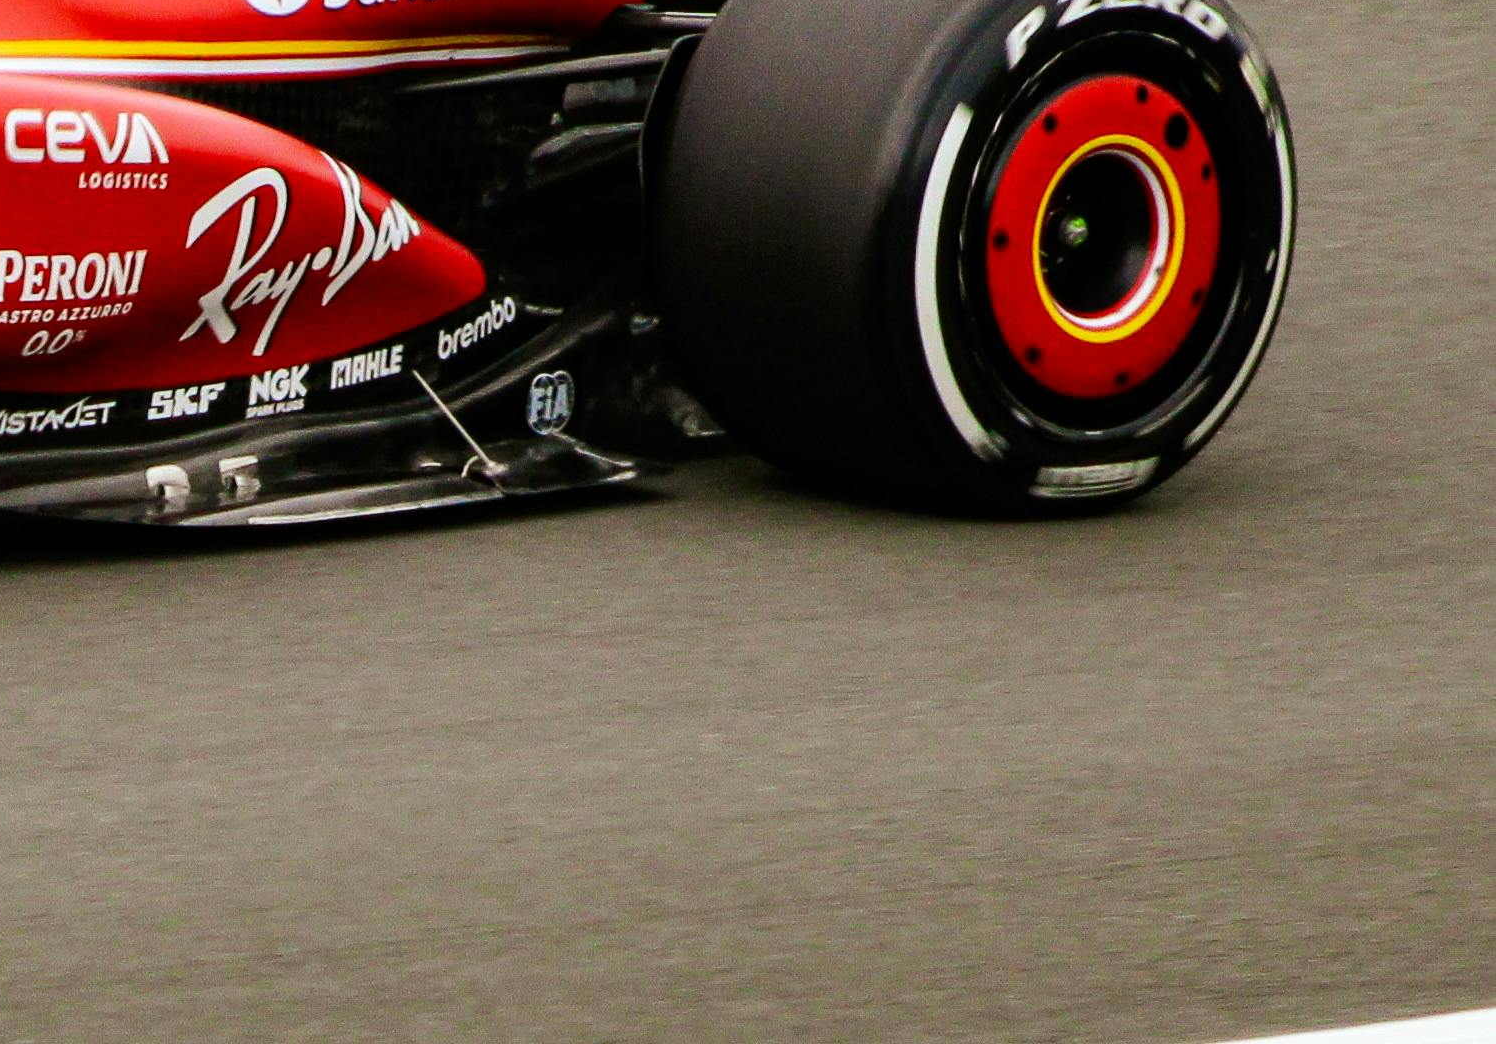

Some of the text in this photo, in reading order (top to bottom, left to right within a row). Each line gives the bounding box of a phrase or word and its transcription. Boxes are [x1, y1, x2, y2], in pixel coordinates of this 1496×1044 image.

[1006, 5, 1046, 69] P
[78, 172, 169, 190] LOGISTICS
[57, 302, 133, 322] AZZURRO
[437, 296, 516, 360] brembo
[249, 363, 310, 406] NGK
[330, 344, 404, 390] MAHLE
[147, 382, 226, 421] SKF
[532, 383, 569, 422] FIA
